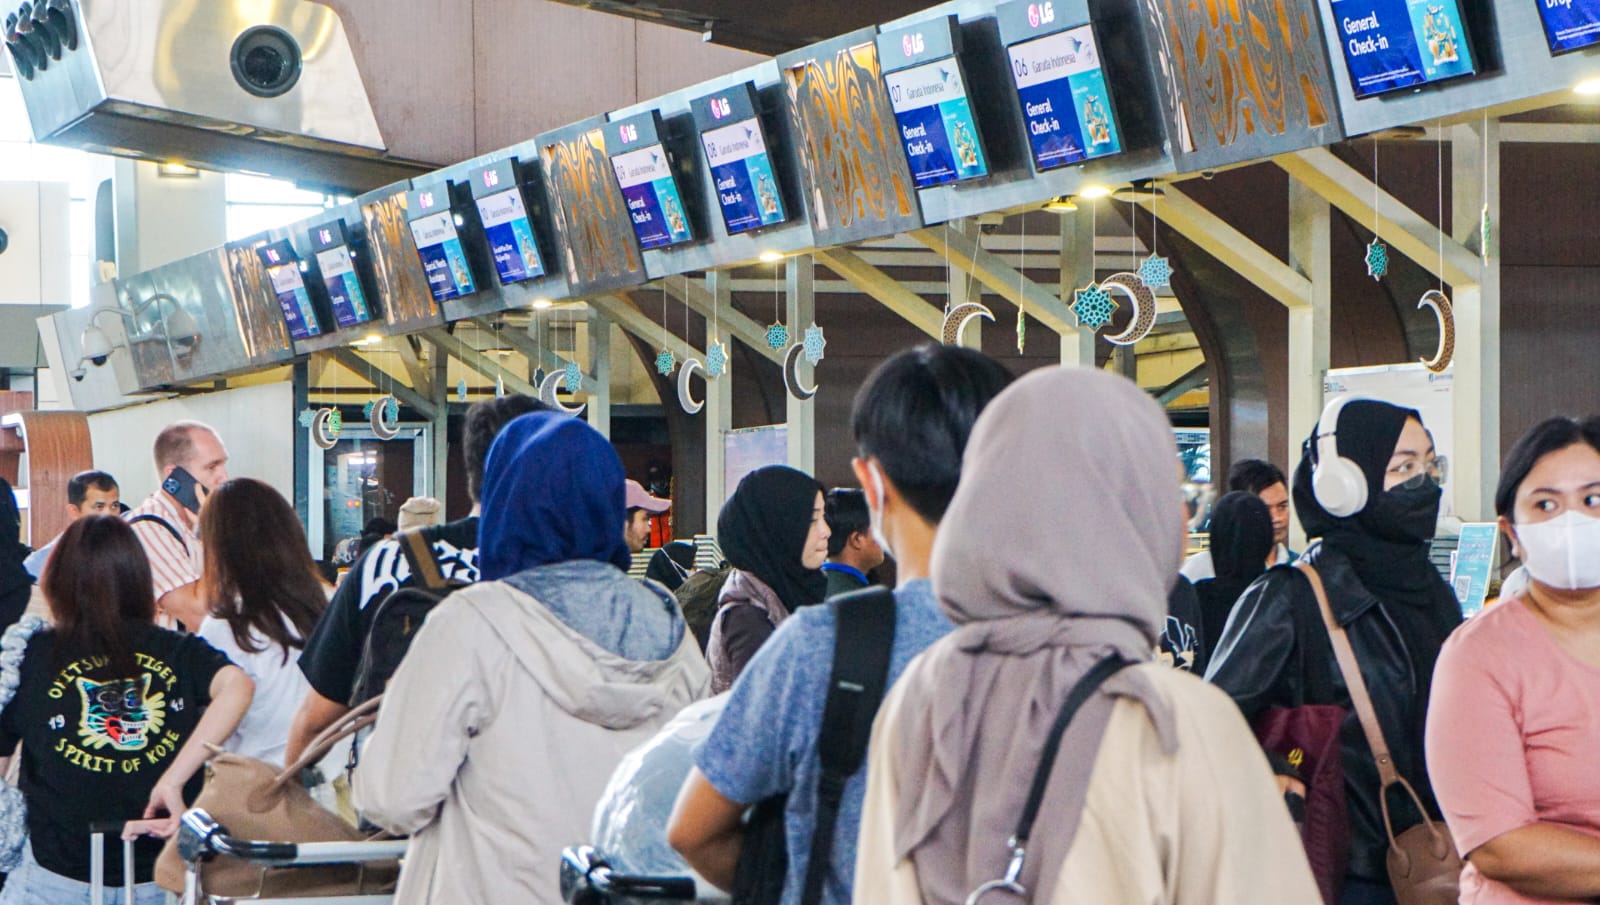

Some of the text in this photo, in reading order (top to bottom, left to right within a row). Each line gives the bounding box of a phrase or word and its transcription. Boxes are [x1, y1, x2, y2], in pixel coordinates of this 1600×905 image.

[1039, 2, 1055, 24] LG
[1343, 11, 1380, 35] General
[912, 33, 925, 54] LG
[1349, 34, 1389, 56] Check-in
[1015, 60, 1028, 77] 06
[1032, 53, 1076, 73] Garuda Indonesia
[891, 85, 901, 102] 07
[906, 82, 944, 100] Garuda Indonesia
[719, 98, 731, 116] LG
[1026, 98, 1052, 117] General
[628, 124, 638, 141] LG
[902, 122, 927, 140] General
[1030, 117, 1060, 135] Check-in
[908, 140, 934, 157] Check-in
[717, 176, 736, 191] General
[628, 196, 645, 211] General
[721, 191, 742, 206] Check-in
[632, 211, 652, 224] Check-in
[134, 652, 177, 691] TIGER
[48, 714, 65, 730] 19
[54, 729, 180, 773] SPIRIT OF KOBE
